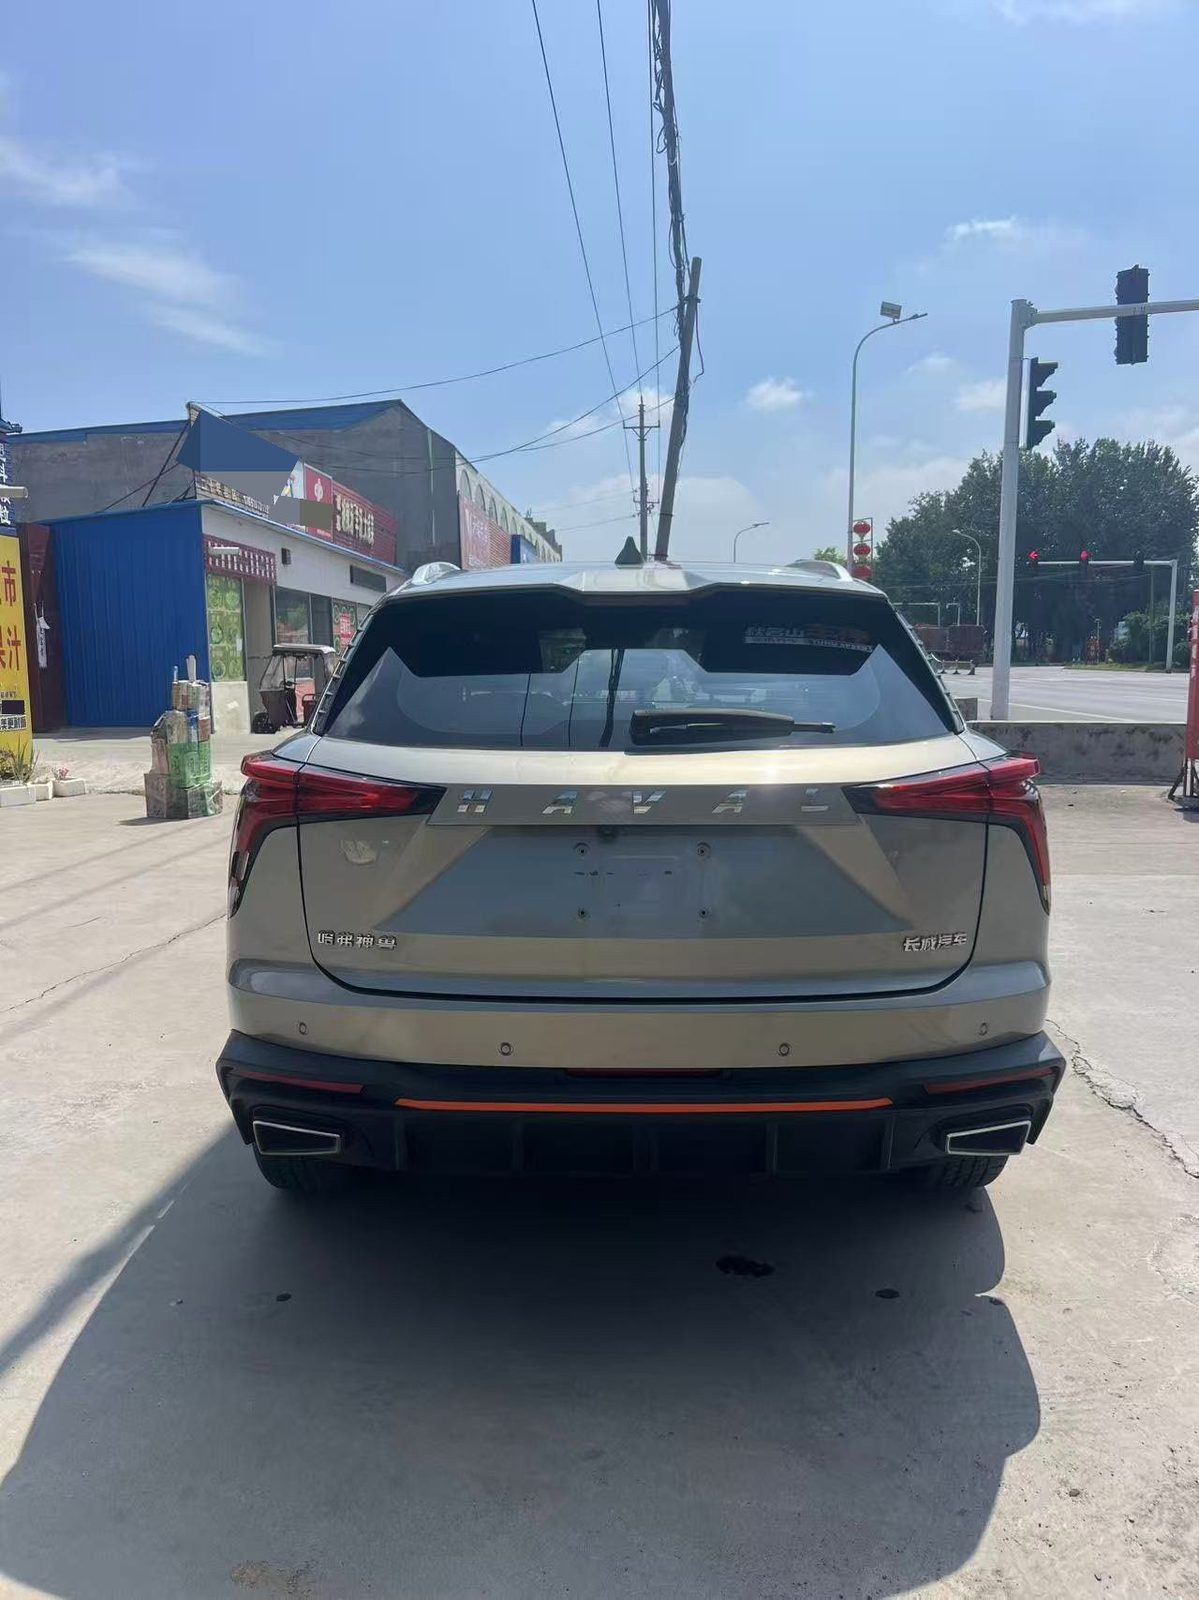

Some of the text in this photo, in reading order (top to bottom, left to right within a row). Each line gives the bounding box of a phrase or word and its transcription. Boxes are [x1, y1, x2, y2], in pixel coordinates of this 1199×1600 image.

[0, 561, 17, 607] 市
[456, 787, 830, 815] HAVAL
[317, 930, 397, 951] 哈弗神兽
[903, 932, 967, 952] 长城汽车
